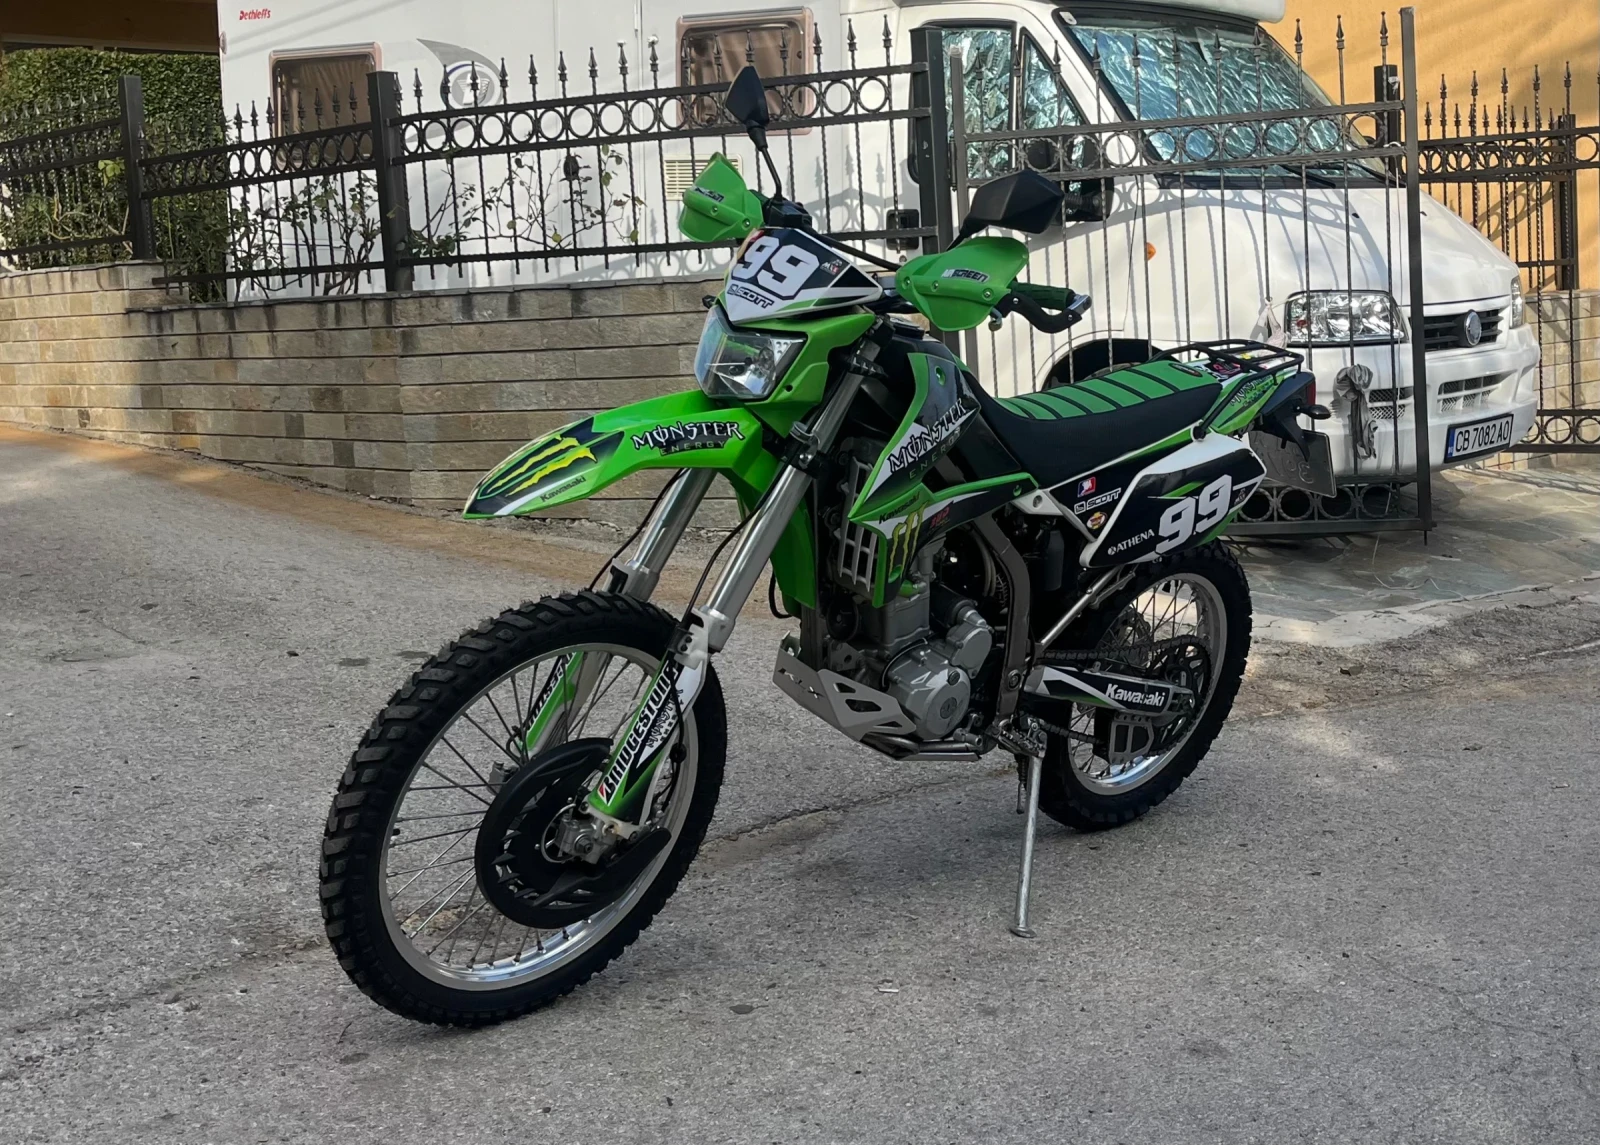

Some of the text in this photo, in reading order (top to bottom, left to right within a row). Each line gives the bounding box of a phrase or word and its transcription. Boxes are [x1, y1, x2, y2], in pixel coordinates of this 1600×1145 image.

[732, 235, 820, 298] 99
[737, 286, 775, 309] SCOTT
[630, 420, 745, 450] MONSTER
[660, 440, 726, 456] ENERGY
[888, 397, 970, 473] MONSTER
[1455, 429, 1470, 452] CB
[1471, 423, 1497, 449] 7082
[540, 475, 587, 503] Kawasaki
[1086, 487, 1122, 511] SCOTT
[1155, 474, 1233, 554] 99
[1117, 528, 1155, 553] ATHENA
[1105, 683, 1166, 707] Kawasaki
